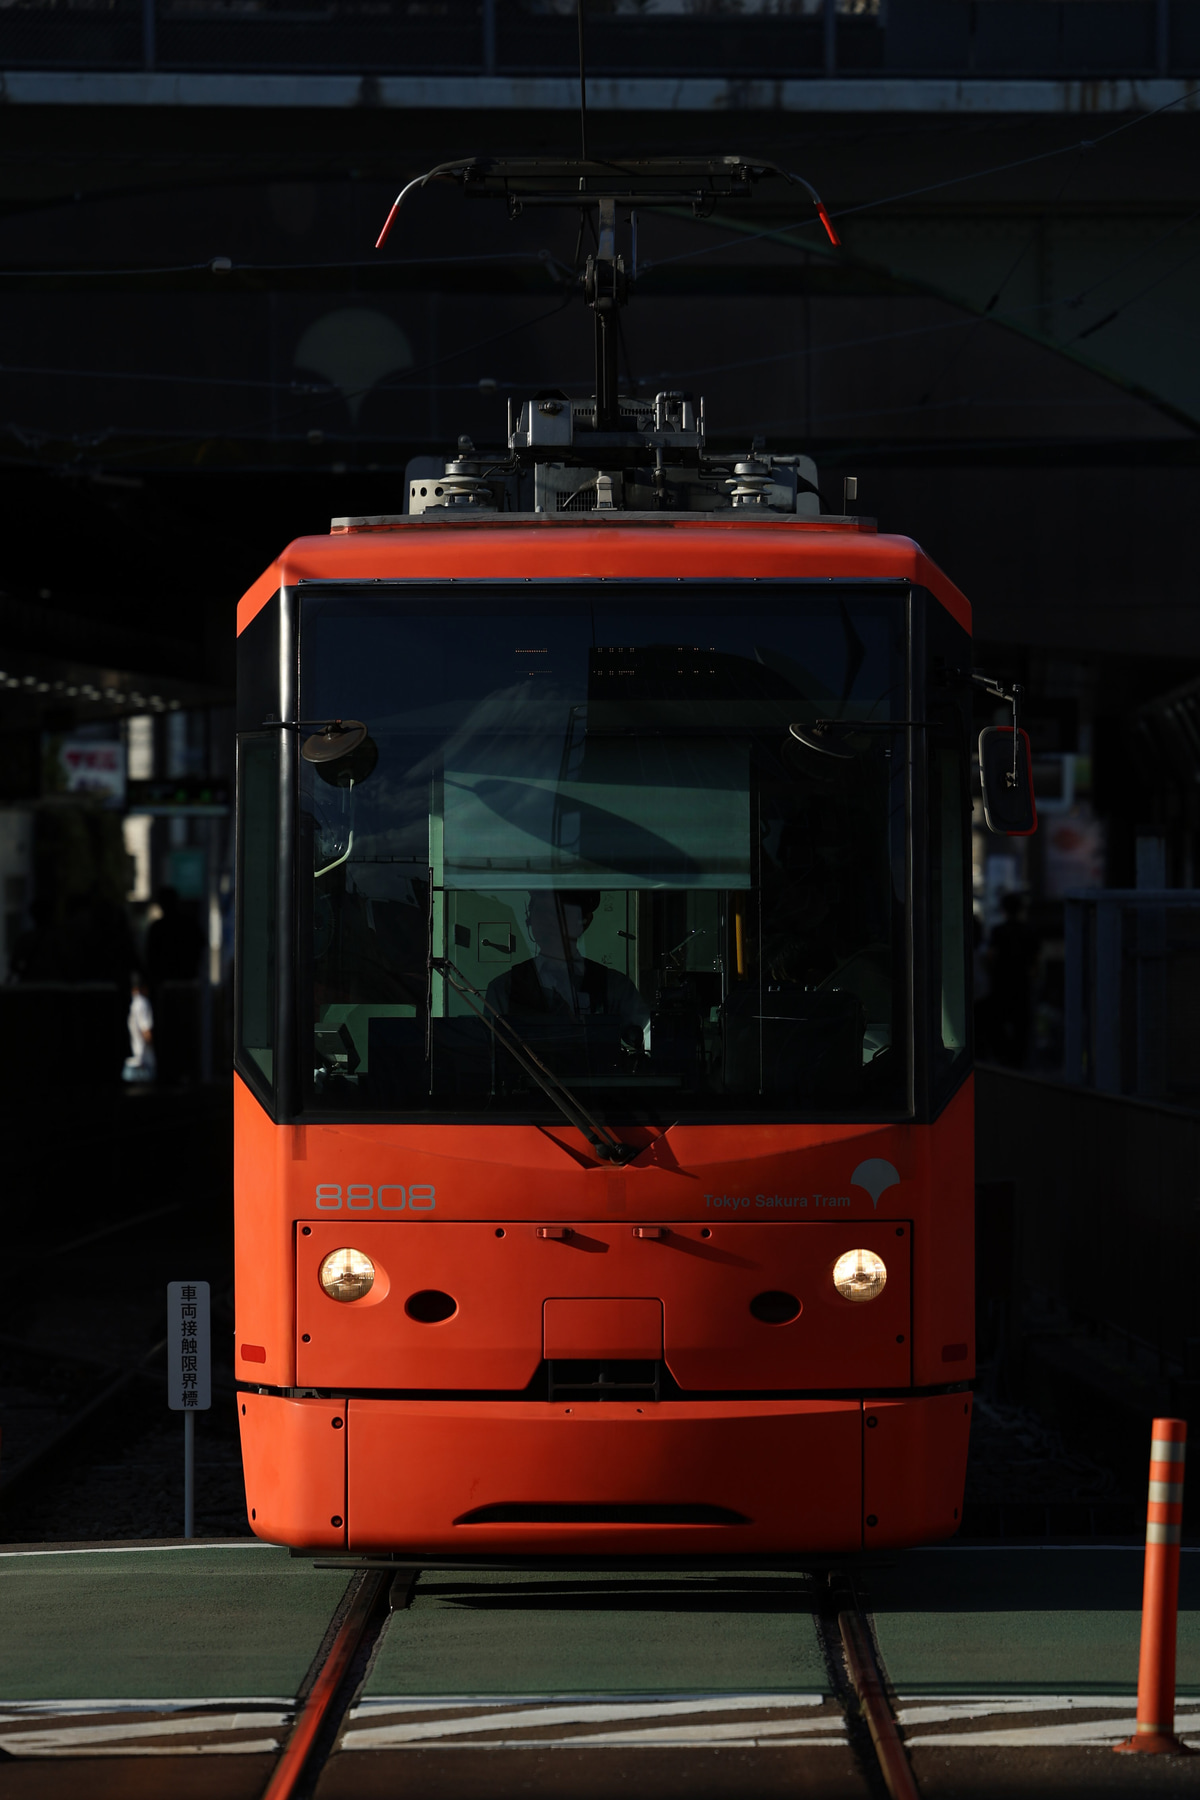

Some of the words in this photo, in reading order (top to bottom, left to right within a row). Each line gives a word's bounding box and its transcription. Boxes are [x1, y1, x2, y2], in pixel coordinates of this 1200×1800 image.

[316, 1184, 436, 1211] 8808
[704, 1194, 750, 1209] Tokyo
[755, 1194, 808, 1207] Sakura
[812, 1194, 851, 1207] Tram
[181, 1285, 198, 1407] 車両接触限界標
